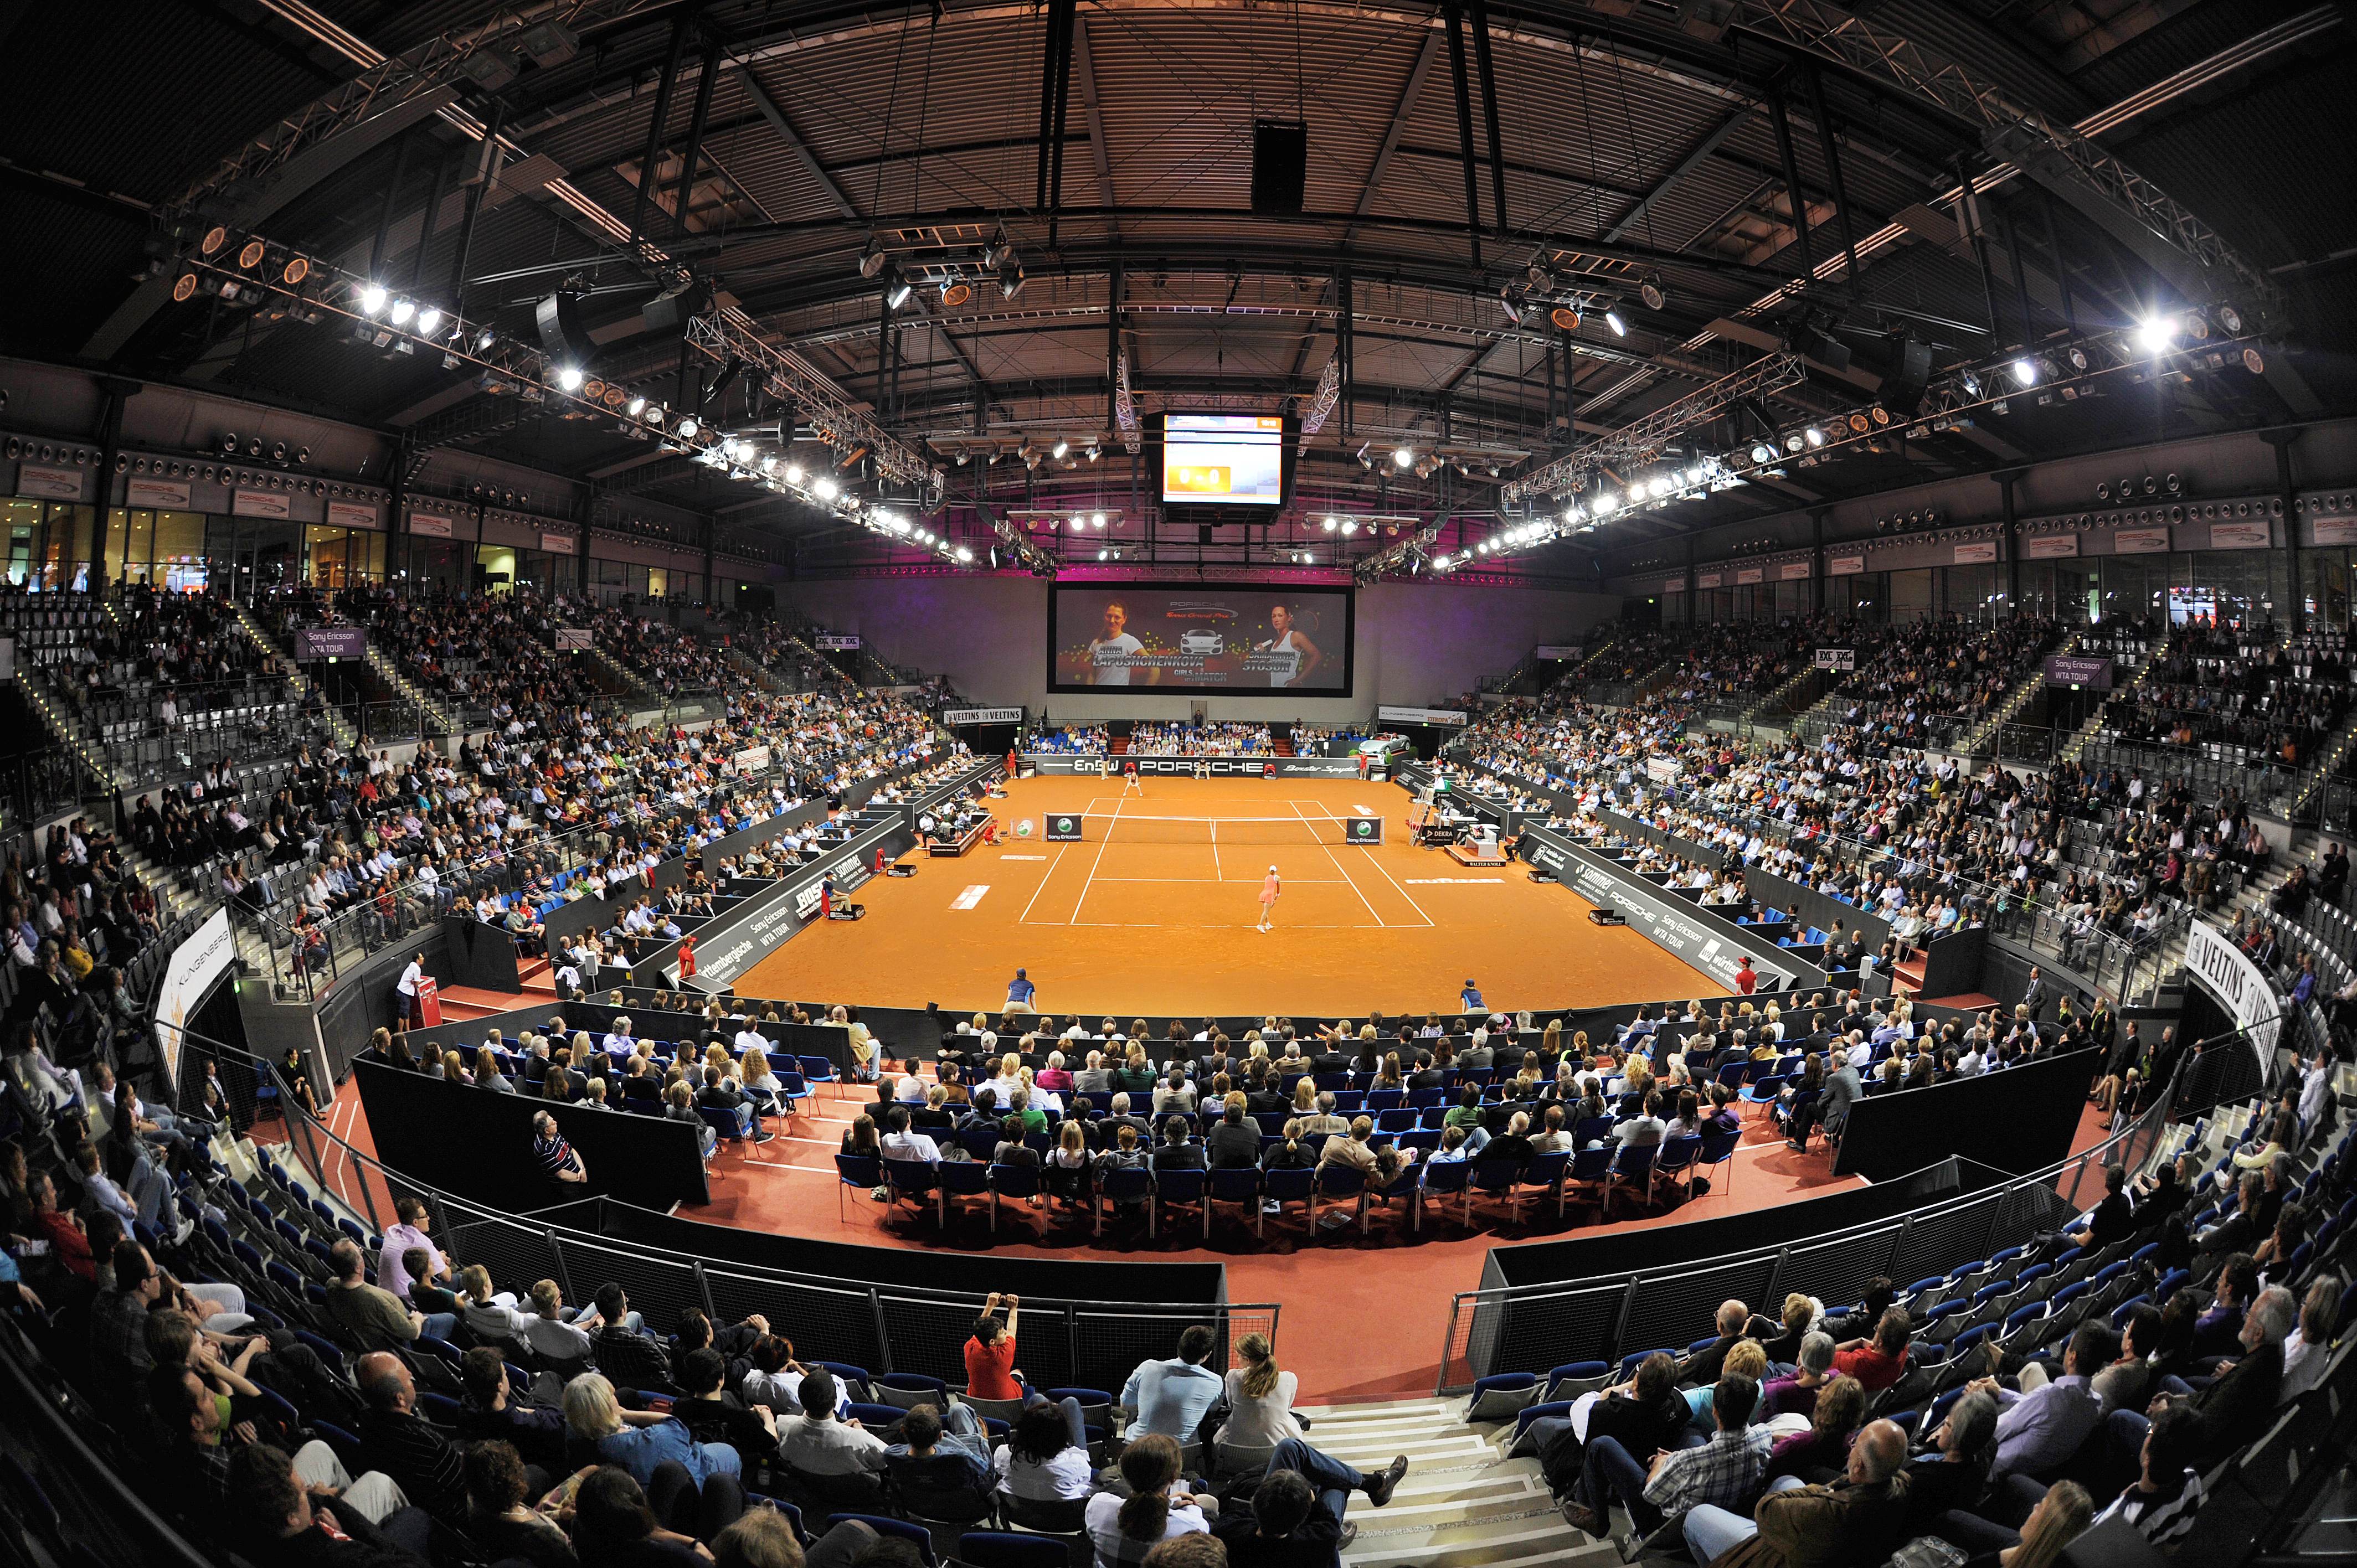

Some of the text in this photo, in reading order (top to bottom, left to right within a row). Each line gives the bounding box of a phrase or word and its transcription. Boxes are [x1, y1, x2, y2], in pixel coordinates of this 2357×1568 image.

[133, 483, 174, 493] PORSCHE
[238, 494, 275, 503] PORSCHE
[331, 506, 365, 515] PORSCHE
[308, 632, 326, 642] Sony
[309, 644, 343, 654] WTA TOUR
[1098, 646, 1123, 654] ANNA
[1249, 651, 1295, 660] SAMANTHA
[1092, 655, 1205, 667] LAPUSHCHENKOVA
[1242, 660, 1290, 672] STOSUR
[2055, 659, 2099, 670] Sony Ericsson
[1195, 672, 1227, 682] MATCH
[2071, 672, 2088, 681] TOUR
[953, 711, 1019, 721] VELTINS VELTINS
[735, 752, 769, 766] PORSCHE
[1074, 759, 1119, 771] EnBW
[1139, 760, 1263, 772] PORSCHE
[1321, 765, 1360, 774] Spyder
[835, 854, 862, 878] sommer
[843, 870, 859, 884] CORPORATE
[1581, 868, 1615, 890] sommer
[1577, 878, 1605, 897] CORPORATE MEDIA
[1609, 891, 1657, 924] PORSCHE
[750, 906, 789, 934] Sony Ericsson
[759, 922, 790, 947] WTA TOUR
[1661, 914, 1703, 943] Sony Ericsson
[1653, 925, 1685, 950] WTA TOUR
[178, 930, 229, 986] KLINGENBERG
[696, 940, 754, 978] ürttembergische
[2201, 937, 2246, 1004] VELTINS
